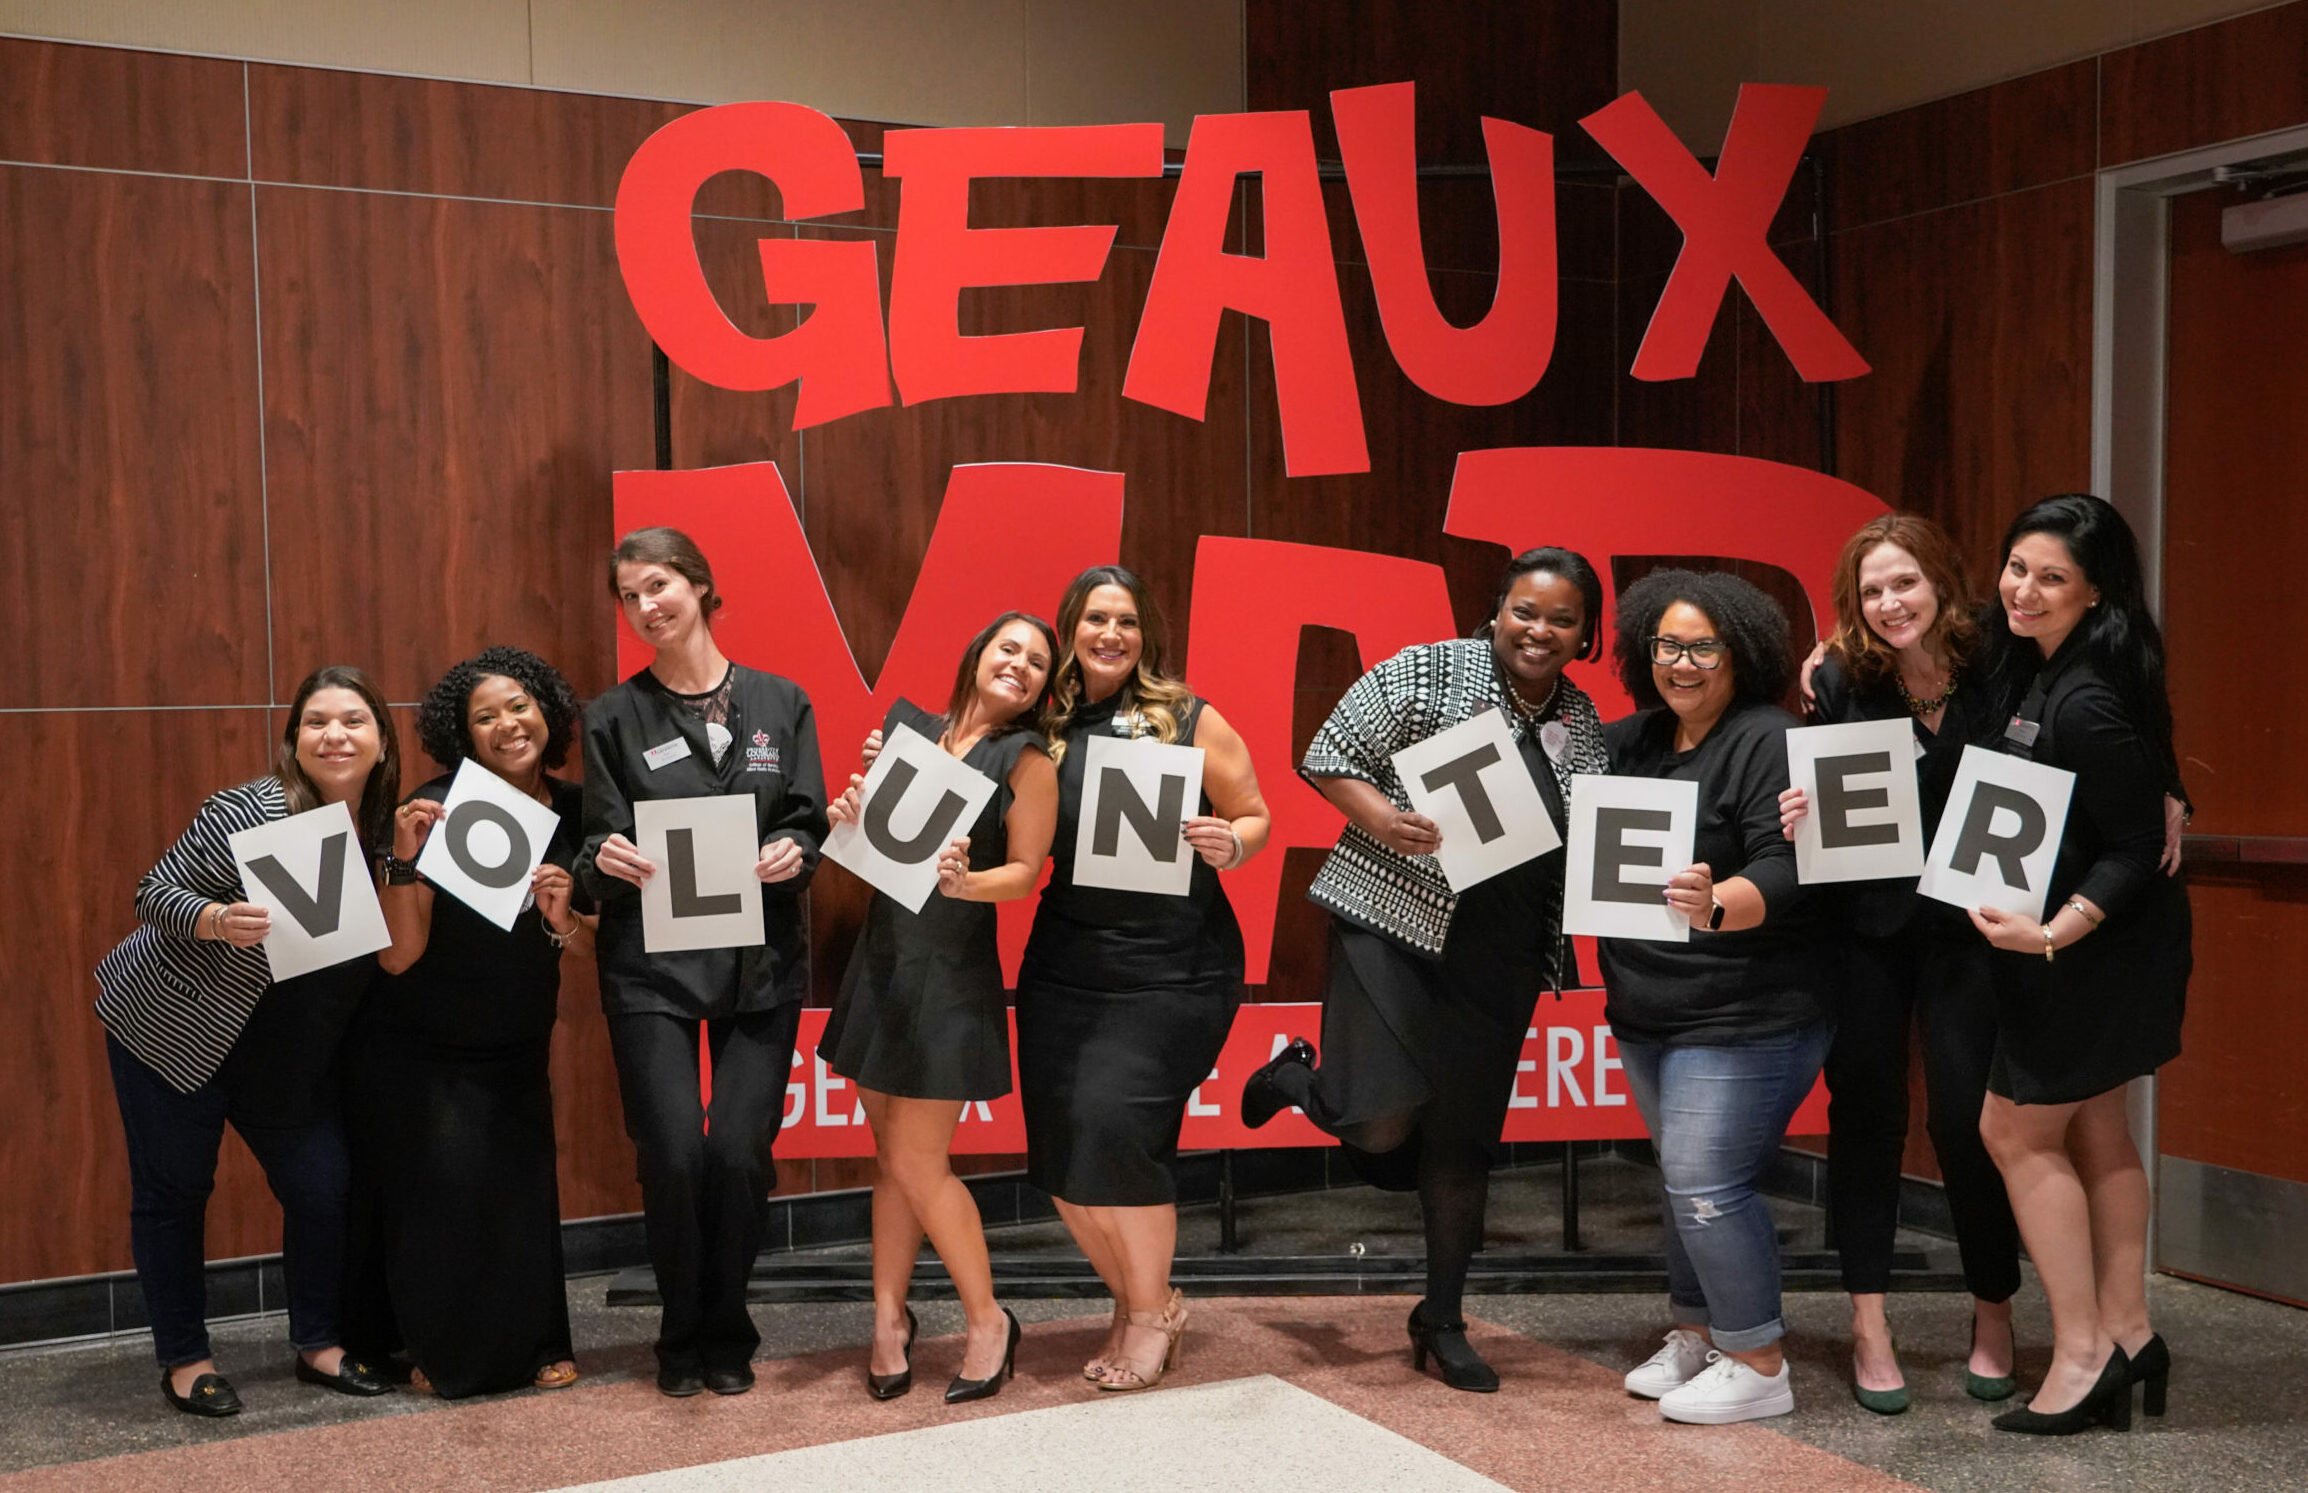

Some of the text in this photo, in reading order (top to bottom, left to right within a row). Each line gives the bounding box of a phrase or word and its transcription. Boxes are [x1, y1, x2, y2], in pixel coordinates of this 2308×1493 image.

[614, 81, 1871, 478] GEAUX
[864, 758, 967, 864] U
[1092, 767, 1189, 862] N
[1421, 743, 1505, 844] T
[1815, 751, 1899, 848] E
[1949, 781, 2046, 891] R
[245, 832, 347, 938] V
[446, 801, 530, 888] O
[666, 828, 742, 918] L
[1591, 807, 1672, 903] E
